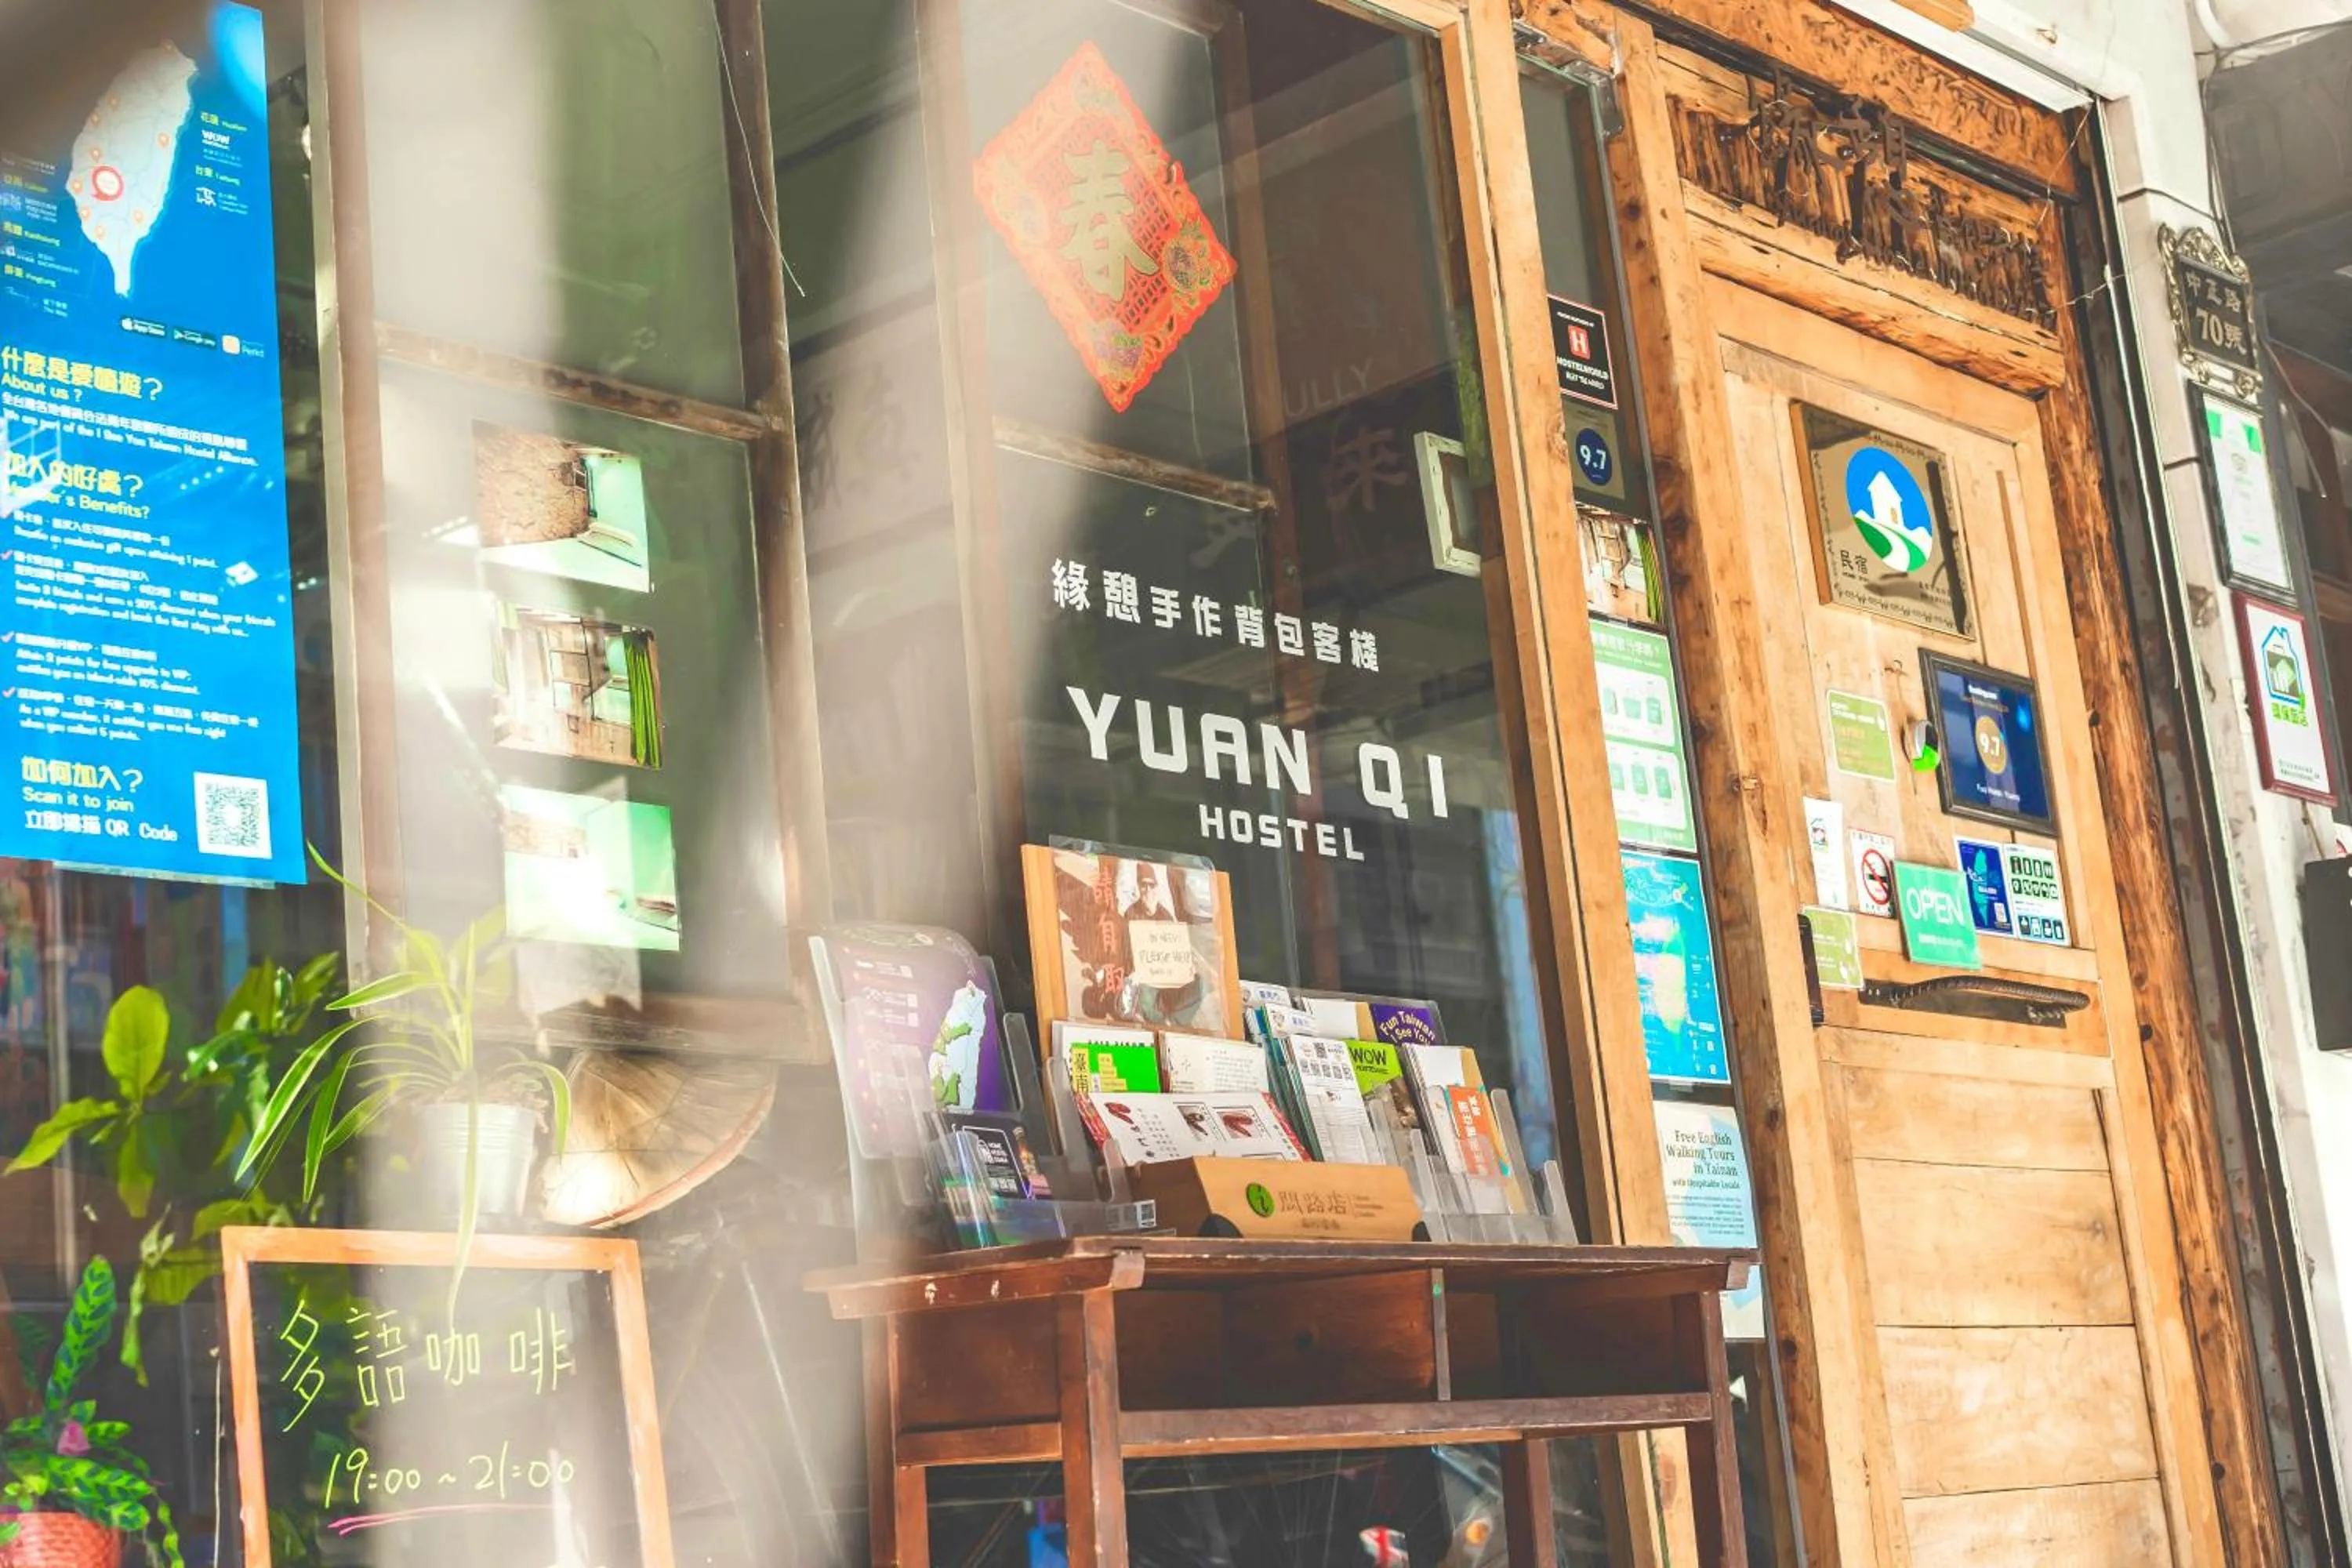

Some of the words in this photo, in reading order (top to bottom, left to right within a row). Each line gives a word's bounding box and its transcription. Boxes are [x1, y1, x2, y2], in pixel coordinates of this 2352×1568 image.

[1059, 139, 1160, 303] 春
[2, 372, 46, 396] About
[1580, 445, 1606, 470] 9.7
[1051, 557, 1380, 673] 緣憩手作背包客棧
[1066, 686, 1312, 795] YUAN
[1359, 742, 1448, 819] QI
[22, 786, 63, 804] Scan
[67, 791, 79, 807] it
[84, 793, 101, 808] to
[106, 794, 135, 813] join
[105, 818, 130, 837] QR
[139, 820, 178, 842] Code
[1200, 804, 1365, 861] HOSTEL
[1907, 887, 1965, 925] OPEN
[1348, 1047, 1387, 1065] WOW
[1666, 1144, 1707, 1161] Walking
[1708, 1147, 1735, 1161] Tours
[1674, 1130, 1696, 1143] Free
[1698, 1131, 1733, 1146] English
[280, 1298, 576, 1432] 多語咖啡
[324, 1447, 422, 1509] 19:00
[469, 1441, 574, 1500] 21:00
